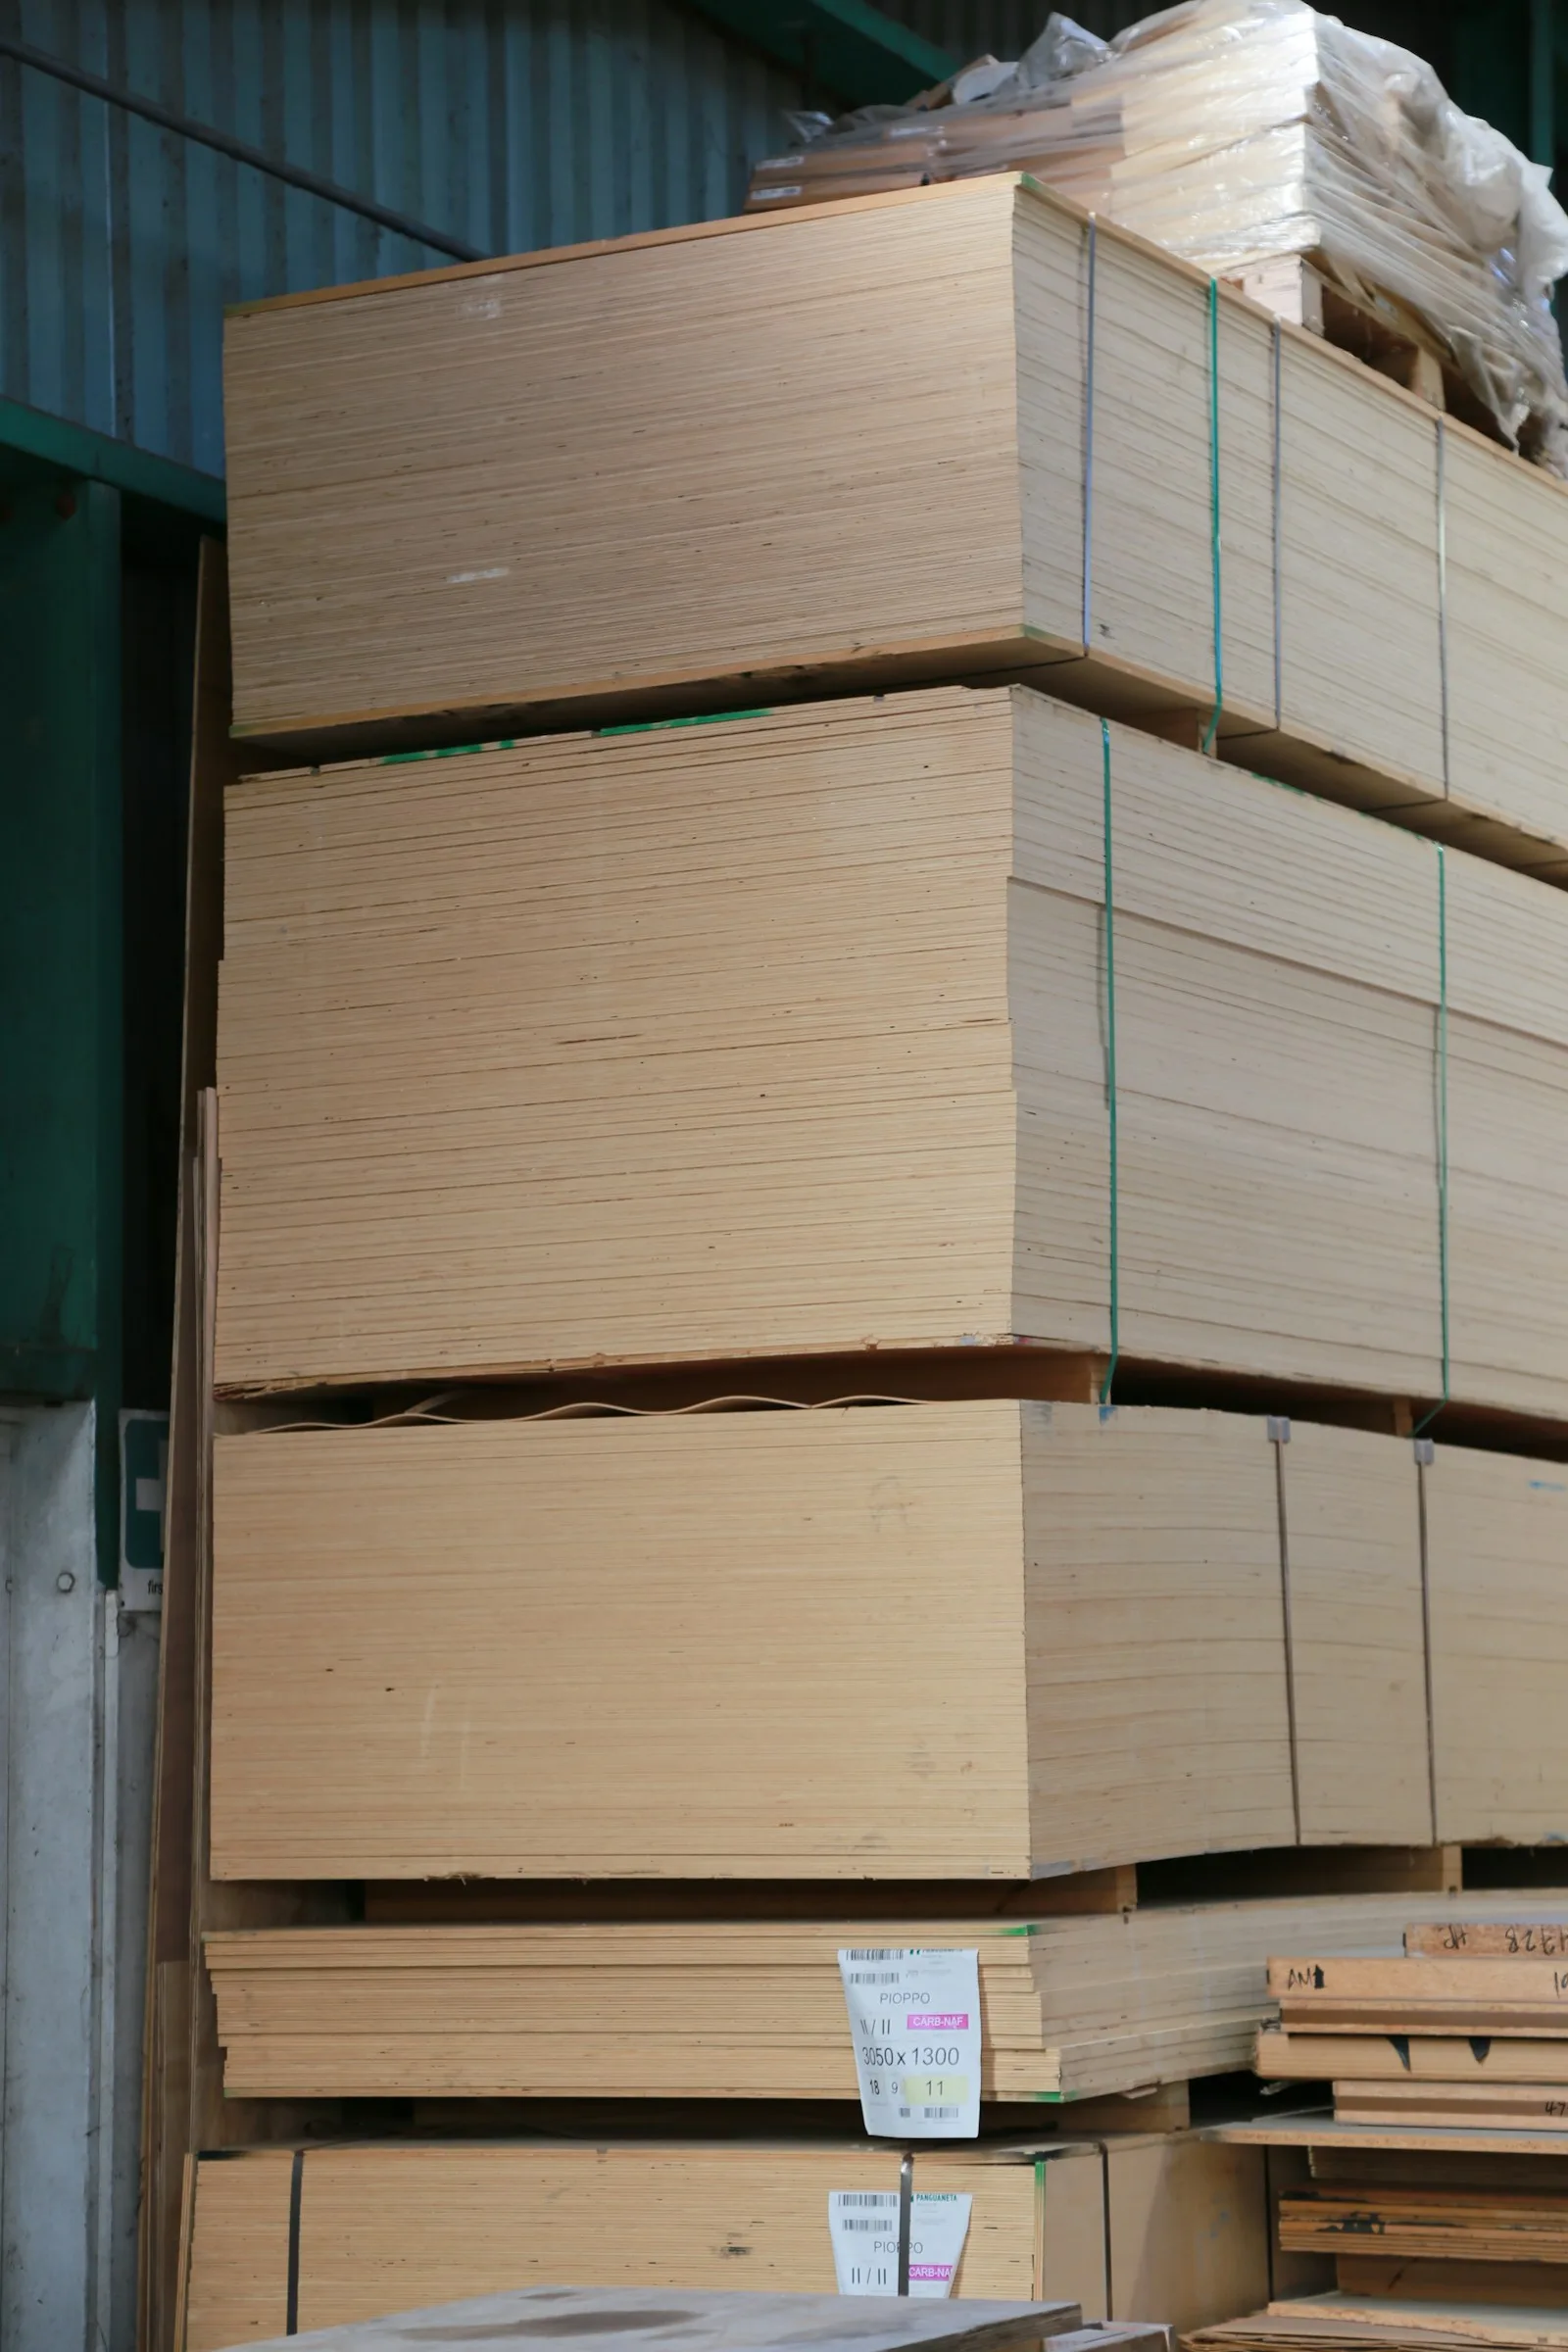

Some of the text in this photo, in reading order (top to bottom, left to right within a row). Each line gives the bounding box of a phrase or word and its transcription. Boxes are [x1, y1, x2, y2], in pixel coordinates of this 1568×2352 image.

[879, 1991, 931, 2005] PIOPPO
[912, 2016, 963, 2028] CARB-NAF
[862, 2046, 894, 2066] 3050
[912, 2046, 959, 2066] 1300
[869, 2079, 880, 2095] 18
[891, 2081, 899, 2094] 9
[1544, 2100, 1568, 2116] 47
[916, 2193, 957, 2202] PANGUANETA
